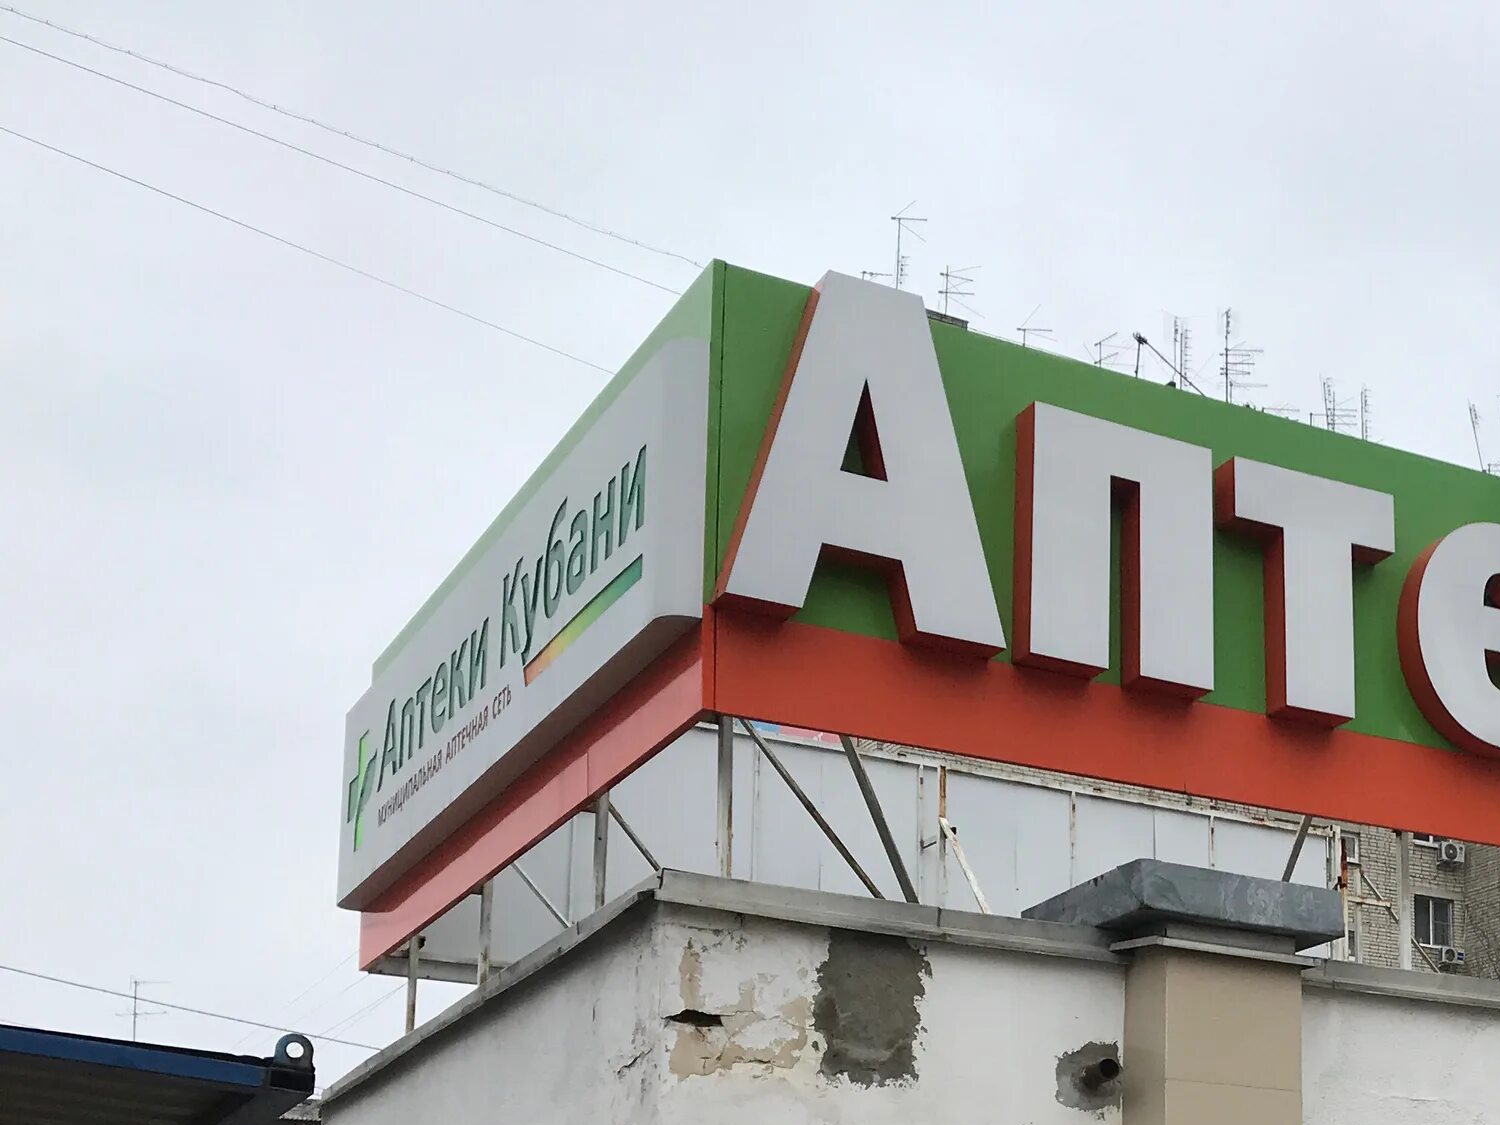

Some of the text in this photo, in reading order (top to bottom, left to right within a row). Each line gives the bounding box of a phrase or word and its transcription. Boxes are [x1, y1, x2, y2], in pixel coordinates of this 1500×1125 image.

[376, 443, 647, 793] Аптеки Кубани
[377, 683, 513, 827] МУНИЦИПАЛЬНАЯ АПТЕЧНАЯ СЕТЬ
